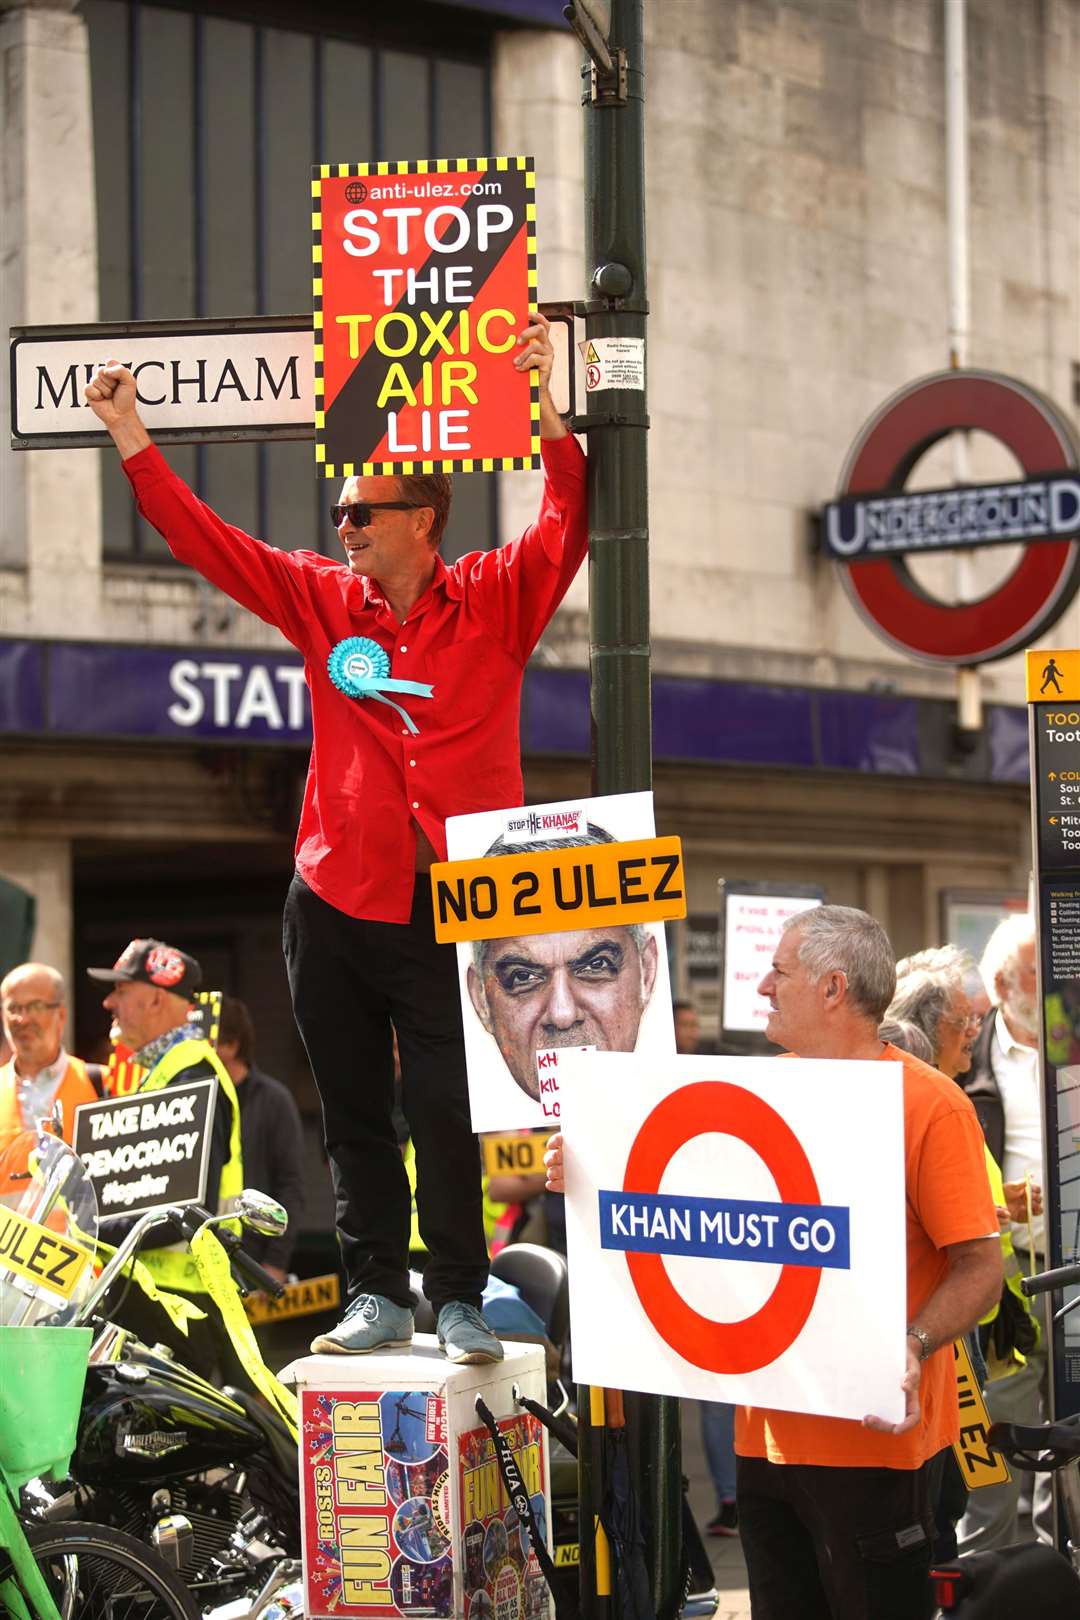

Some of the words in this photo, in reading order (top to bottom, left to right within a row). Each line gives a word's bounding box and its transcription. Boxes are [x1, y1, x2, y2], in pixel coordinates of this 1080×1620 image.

[370, 182, 502, 199] anti-ulez.com
[343, 204, 514, 257] STOP
[372, 266, 474, 306] THE
[335, 308, 517, 360] TOXIC
[376, 360, 479, 408] AIR
[387, 409, 471, 453] LIE
[827, 479, 1080, 555] UNDERGROUND
[168, 659, 307, 731] STAT
[508, 821, 526, 830] STOP
[437, 876, 498, 924] NO
[511, 871, 541, 916] 2
[553, 855, 682, 910] ULEZ
[89, 1106, 140, 1140] TAKE
[140, 1095, 197, 1130] BACK
[80, 1131, 199, 1180] DEMOCRACY
[496, 1141, 533, 1169] NO
[0, 1219, 79, 1286] ULEZ
[611, 1203, 691, 1241] KHAN
[700, 1210, 779, 1248] MUST
[788, 1217, 836, 1253] GO
[332, 1401, 387, 1505] FAIR
[315, 1466, 335, 1540] ROSE'S
[432, 1500, 439, 1512] AS
[464, 1461, 498, 1524] FUN
[337, 1515, 394, 1605] FUN
